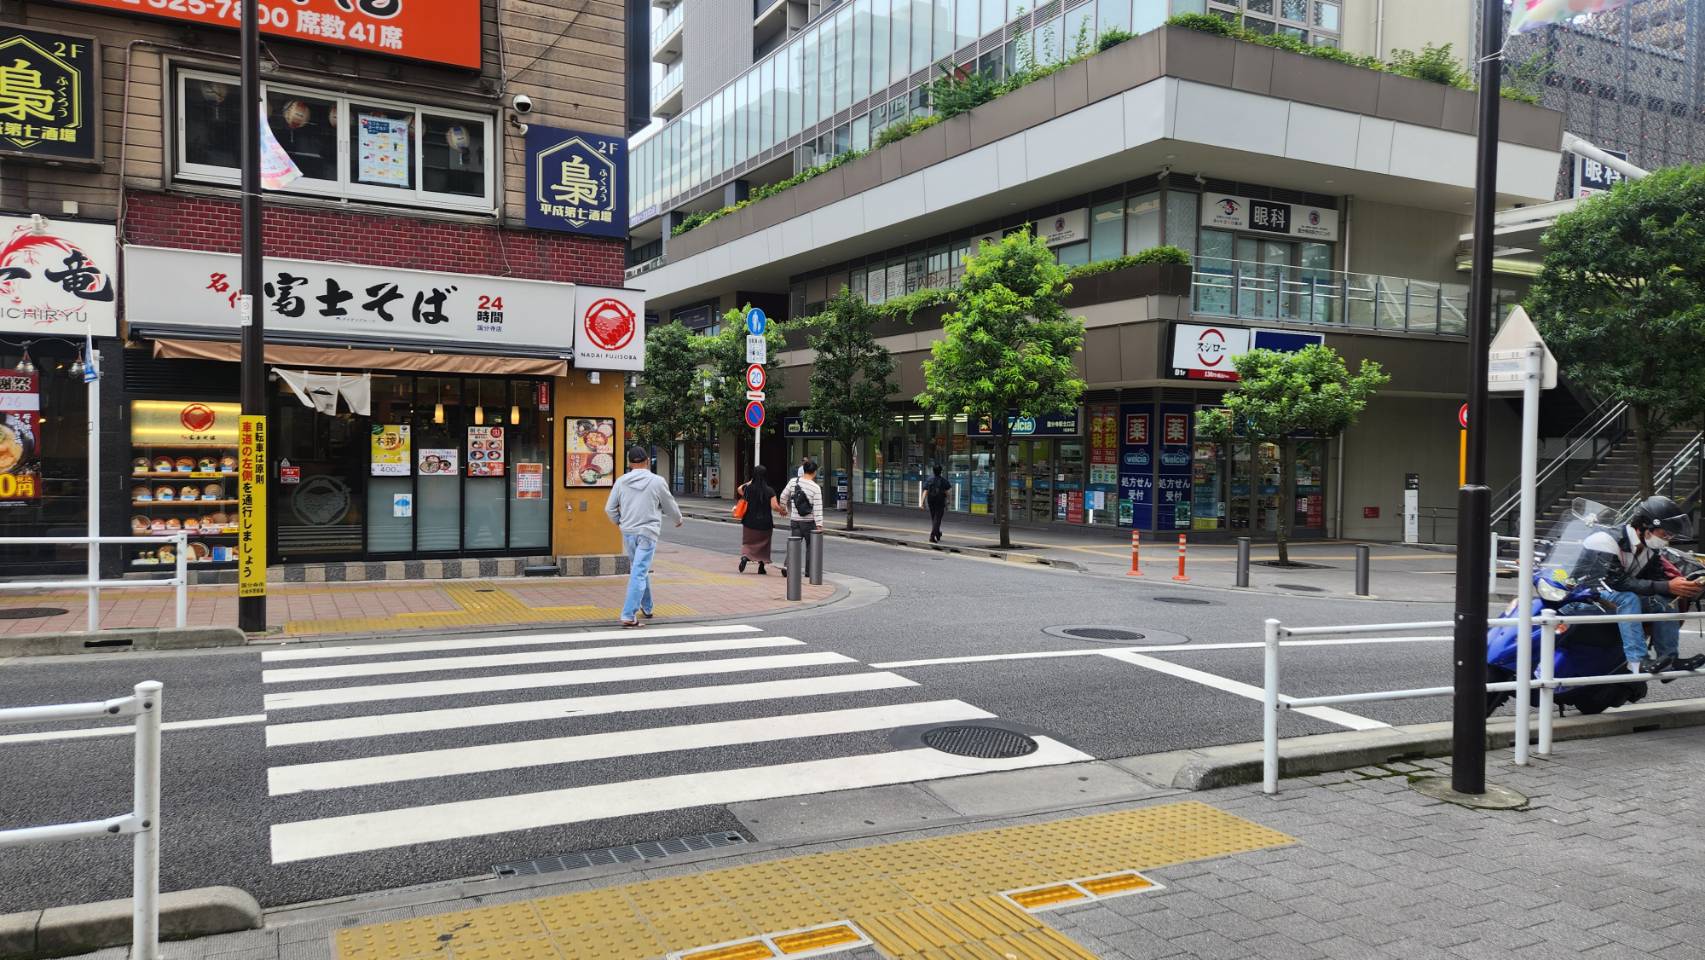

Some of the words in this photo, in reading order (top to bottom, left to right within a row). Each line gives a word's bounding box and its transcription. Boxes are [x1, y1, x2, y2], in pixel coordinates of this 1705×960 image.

[54, 42, 85, 58] 2F
[56, 77, 69, 118] ふくろう
[0, 121, 77, 143] 第七酒場
[598, 141, 619, 155] 2F
[550, 155, 599, 206] 梟
[600, 169, 608, 202] ふくろう
[540, 203, 612, 223] 平成第七酒場
[1254, 206, 1286, 229] 眼科
[264, 272, 458, 325] 富士そば
[478, 295, 504, 310] 24
[1, 307, 88, 323] ICHIRYU
[477, 311, 504, 324] 時間
[1197, 343, 1226, 352] スシロー
[752, 371, 761, 384] 20
[1129, 418, 1145, 440] 薬
[1167, 418, 1184, 440] 薬
[256, 422, 264, 485] 自転車は原則
[1121, 478, 1152, 488] 処方せん
[1159, 479, 1191, 489] 処方せん
[242, 421, 253, 578] 車道の左側を通行しましょう
[1128, 489, 1145, 501] 受付
[1166, 490, 1183, 502] 受付
